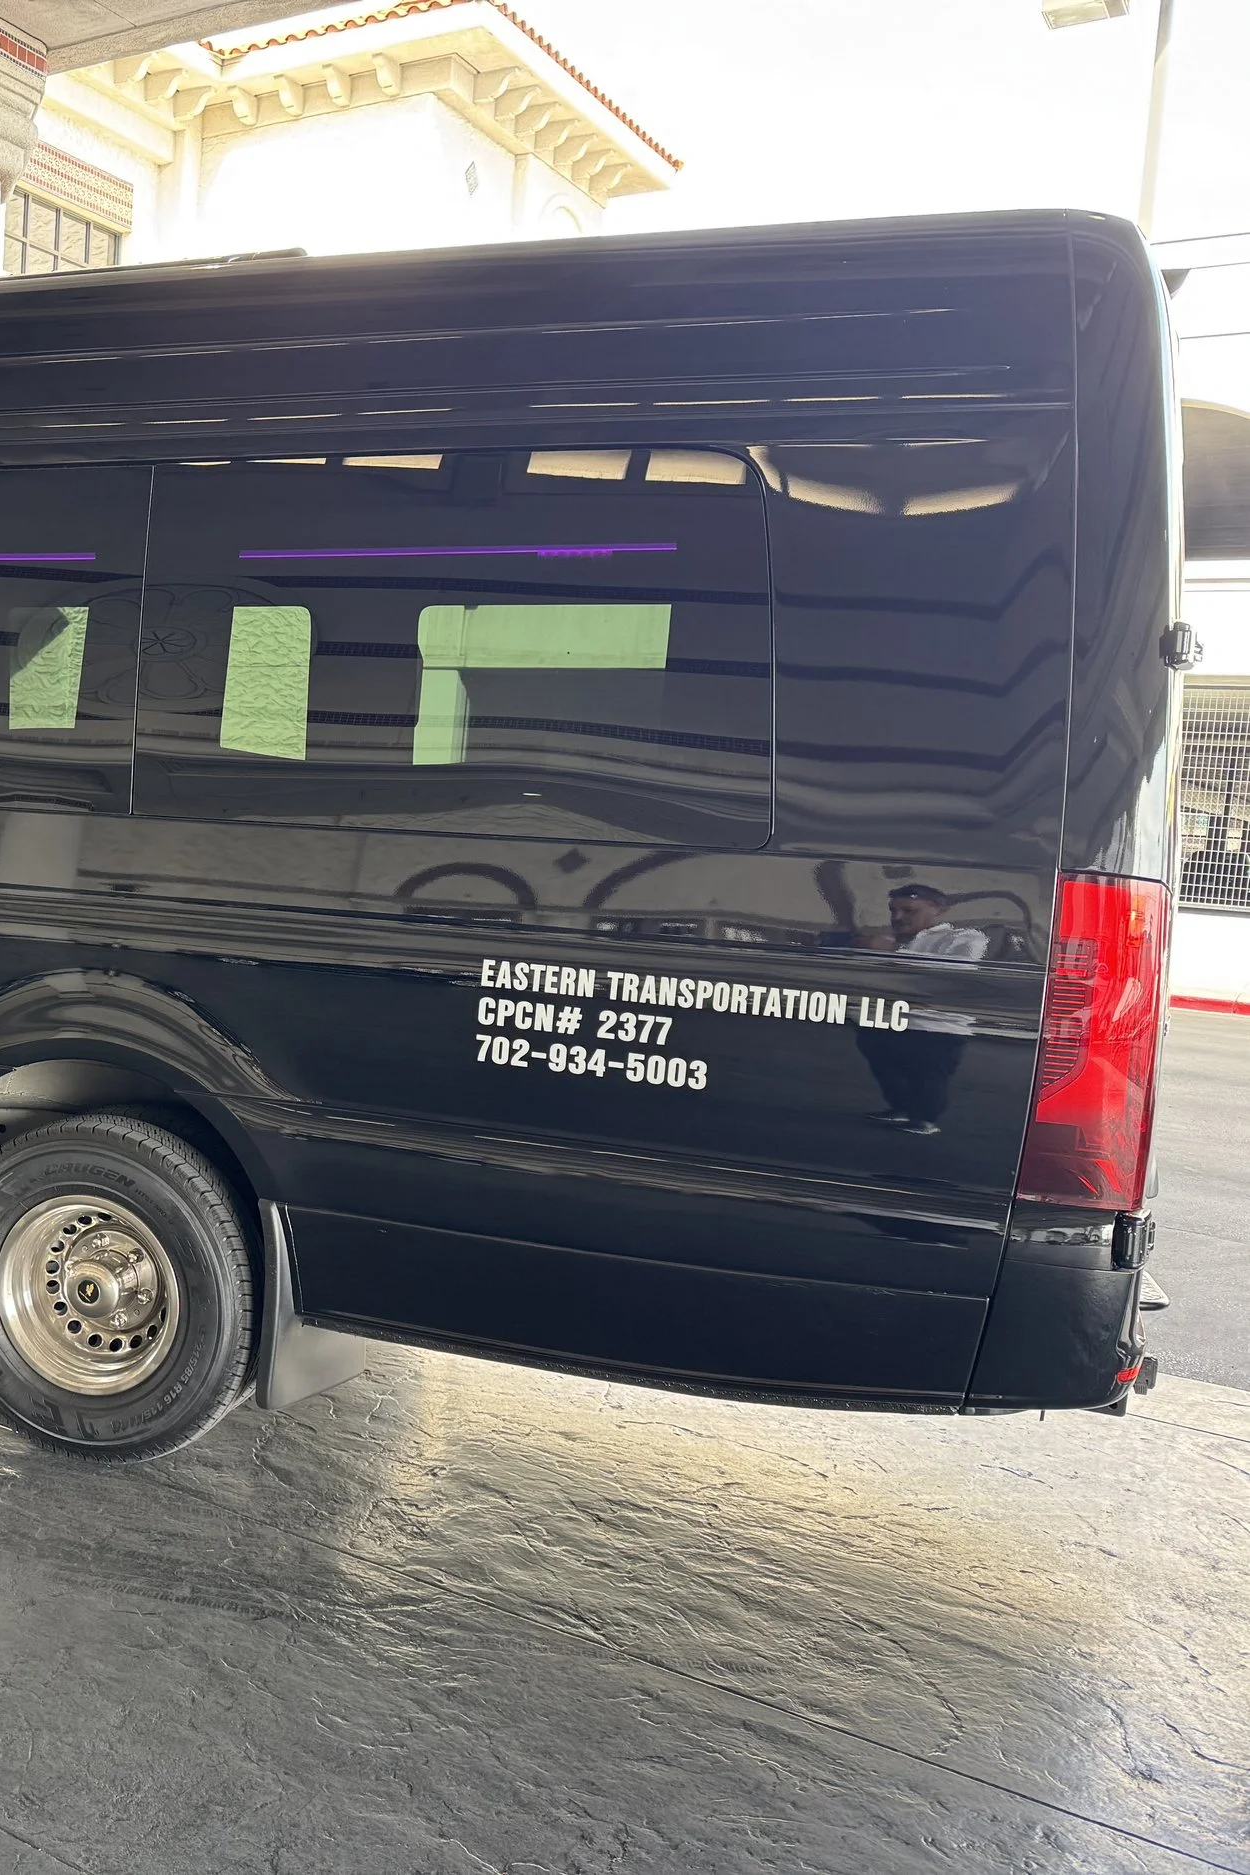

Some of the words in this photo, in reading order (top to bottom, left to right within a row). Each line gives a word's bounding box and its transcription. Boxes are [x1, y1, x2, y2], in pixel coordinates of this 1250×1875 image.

[477, 996, 583, 1035] CPCN#
[596, 1010, 673, 1046] 2377
[480, 958, 596, 998] EASTERN
[607, 971, 848, 1025] TRANSPORTATION
[859, 996, 910, 1032] LLC
[476, 1034, 708, 1090] 702-934-5003
[163, 1381, 183, 1404] R16
